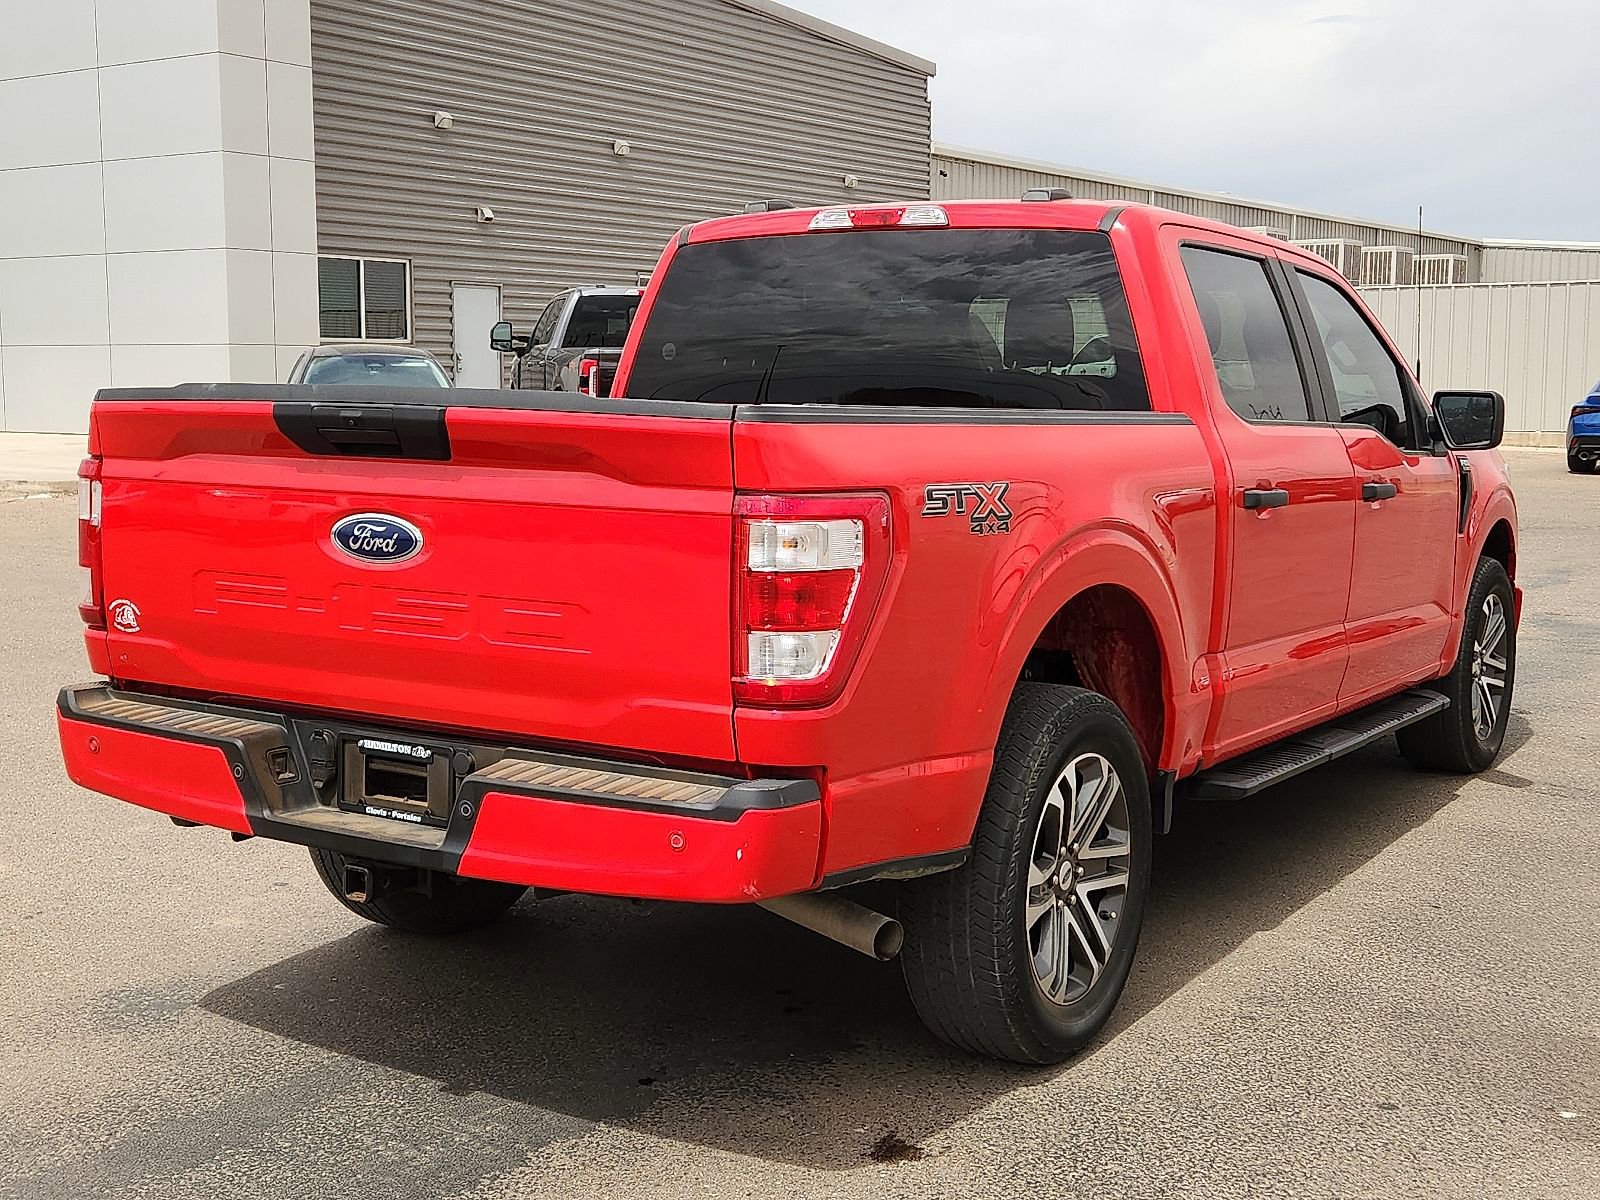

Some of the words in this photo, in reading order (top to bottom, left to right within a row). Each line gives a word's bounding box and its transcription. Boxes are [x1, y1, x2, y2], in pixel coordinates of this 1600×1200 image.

[921, 482, 1013, 522] STX
[349, 523, 398, 552] Ford
[192, 569, 594, 655] F-150
[363, 739, 411, 755] HAMILTON
[365, 806, 387, 817] Clovis
[391, 810, 422, 823] Portales
